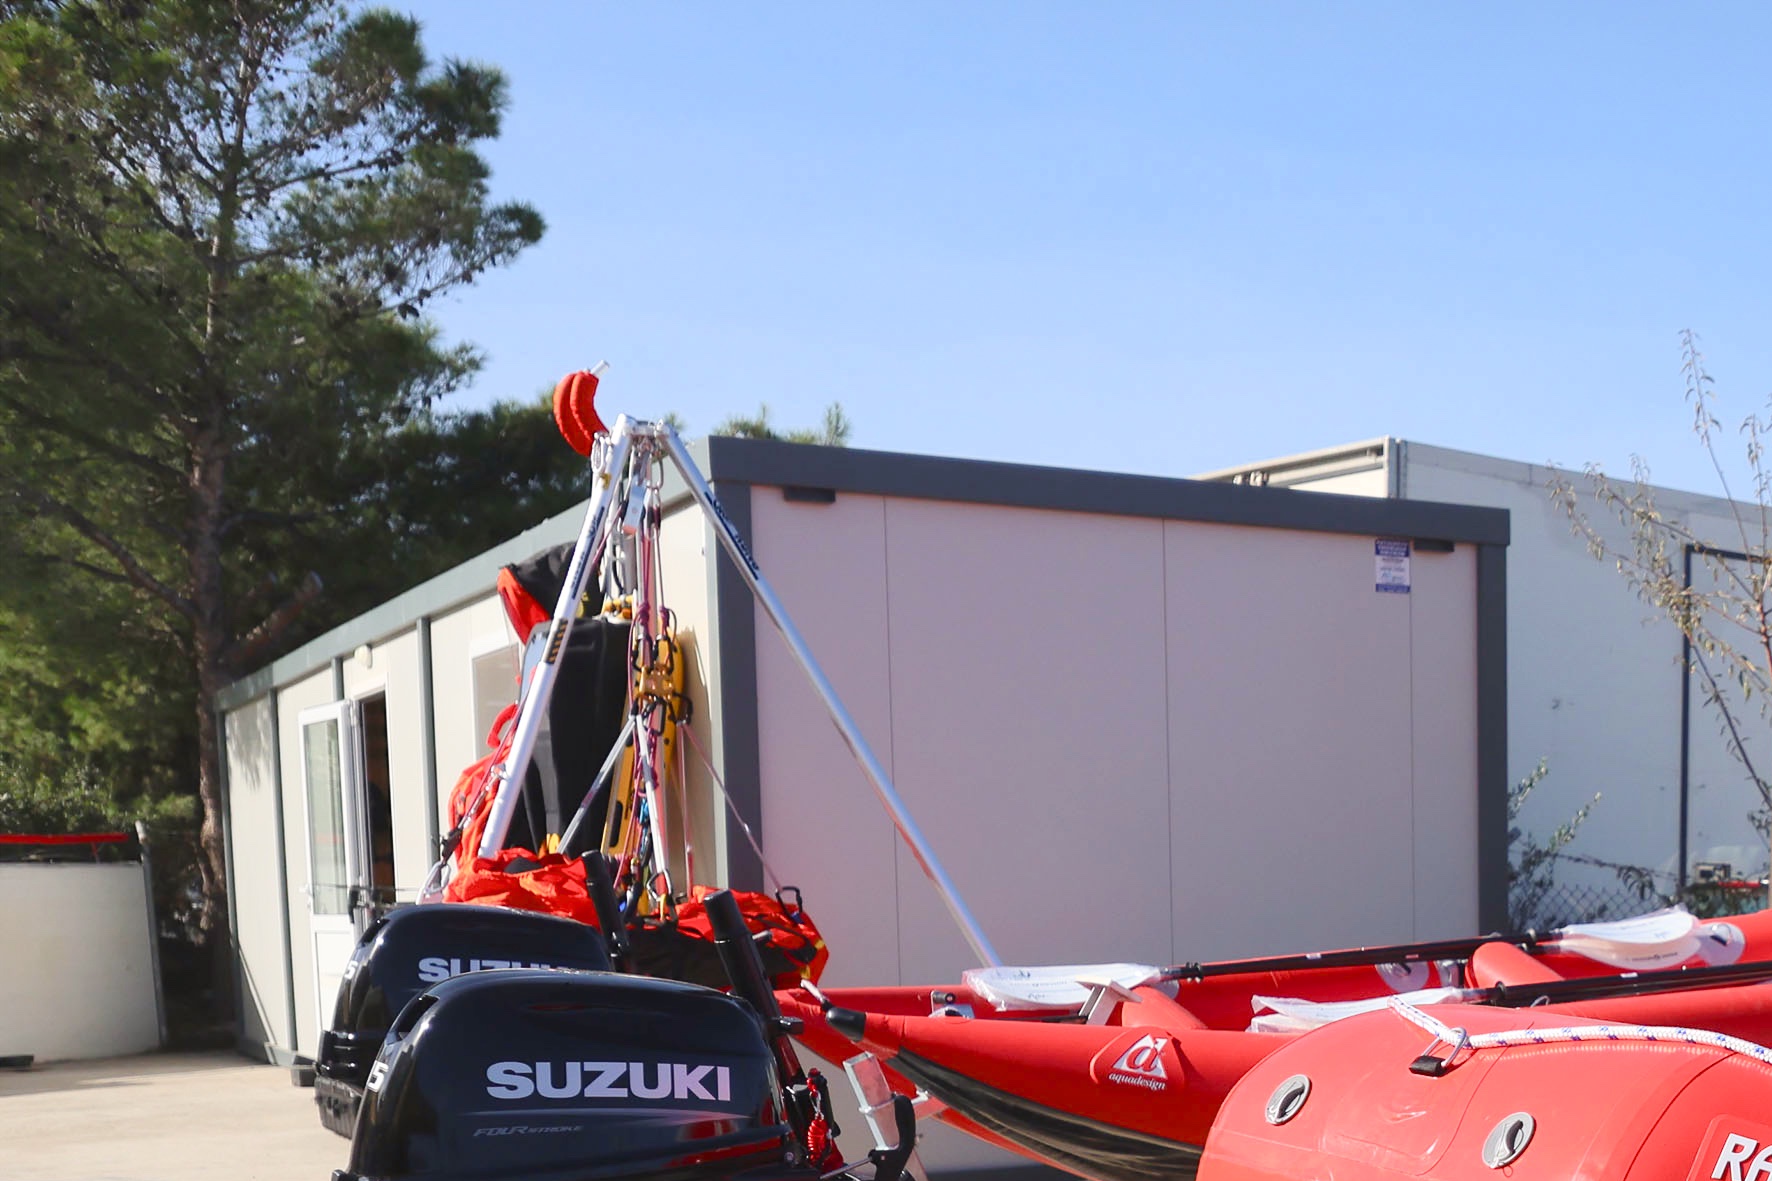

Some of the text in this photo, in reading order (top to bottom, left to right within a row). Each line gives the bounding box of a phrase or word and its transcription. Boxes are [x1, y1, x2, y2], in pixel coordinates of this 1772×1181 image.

[486, 1061, 731, 1101] SUZUKI
[1108, 1072, 1166, 1091] aquadesign
[473, 1126, 528, 1137] FOUR
